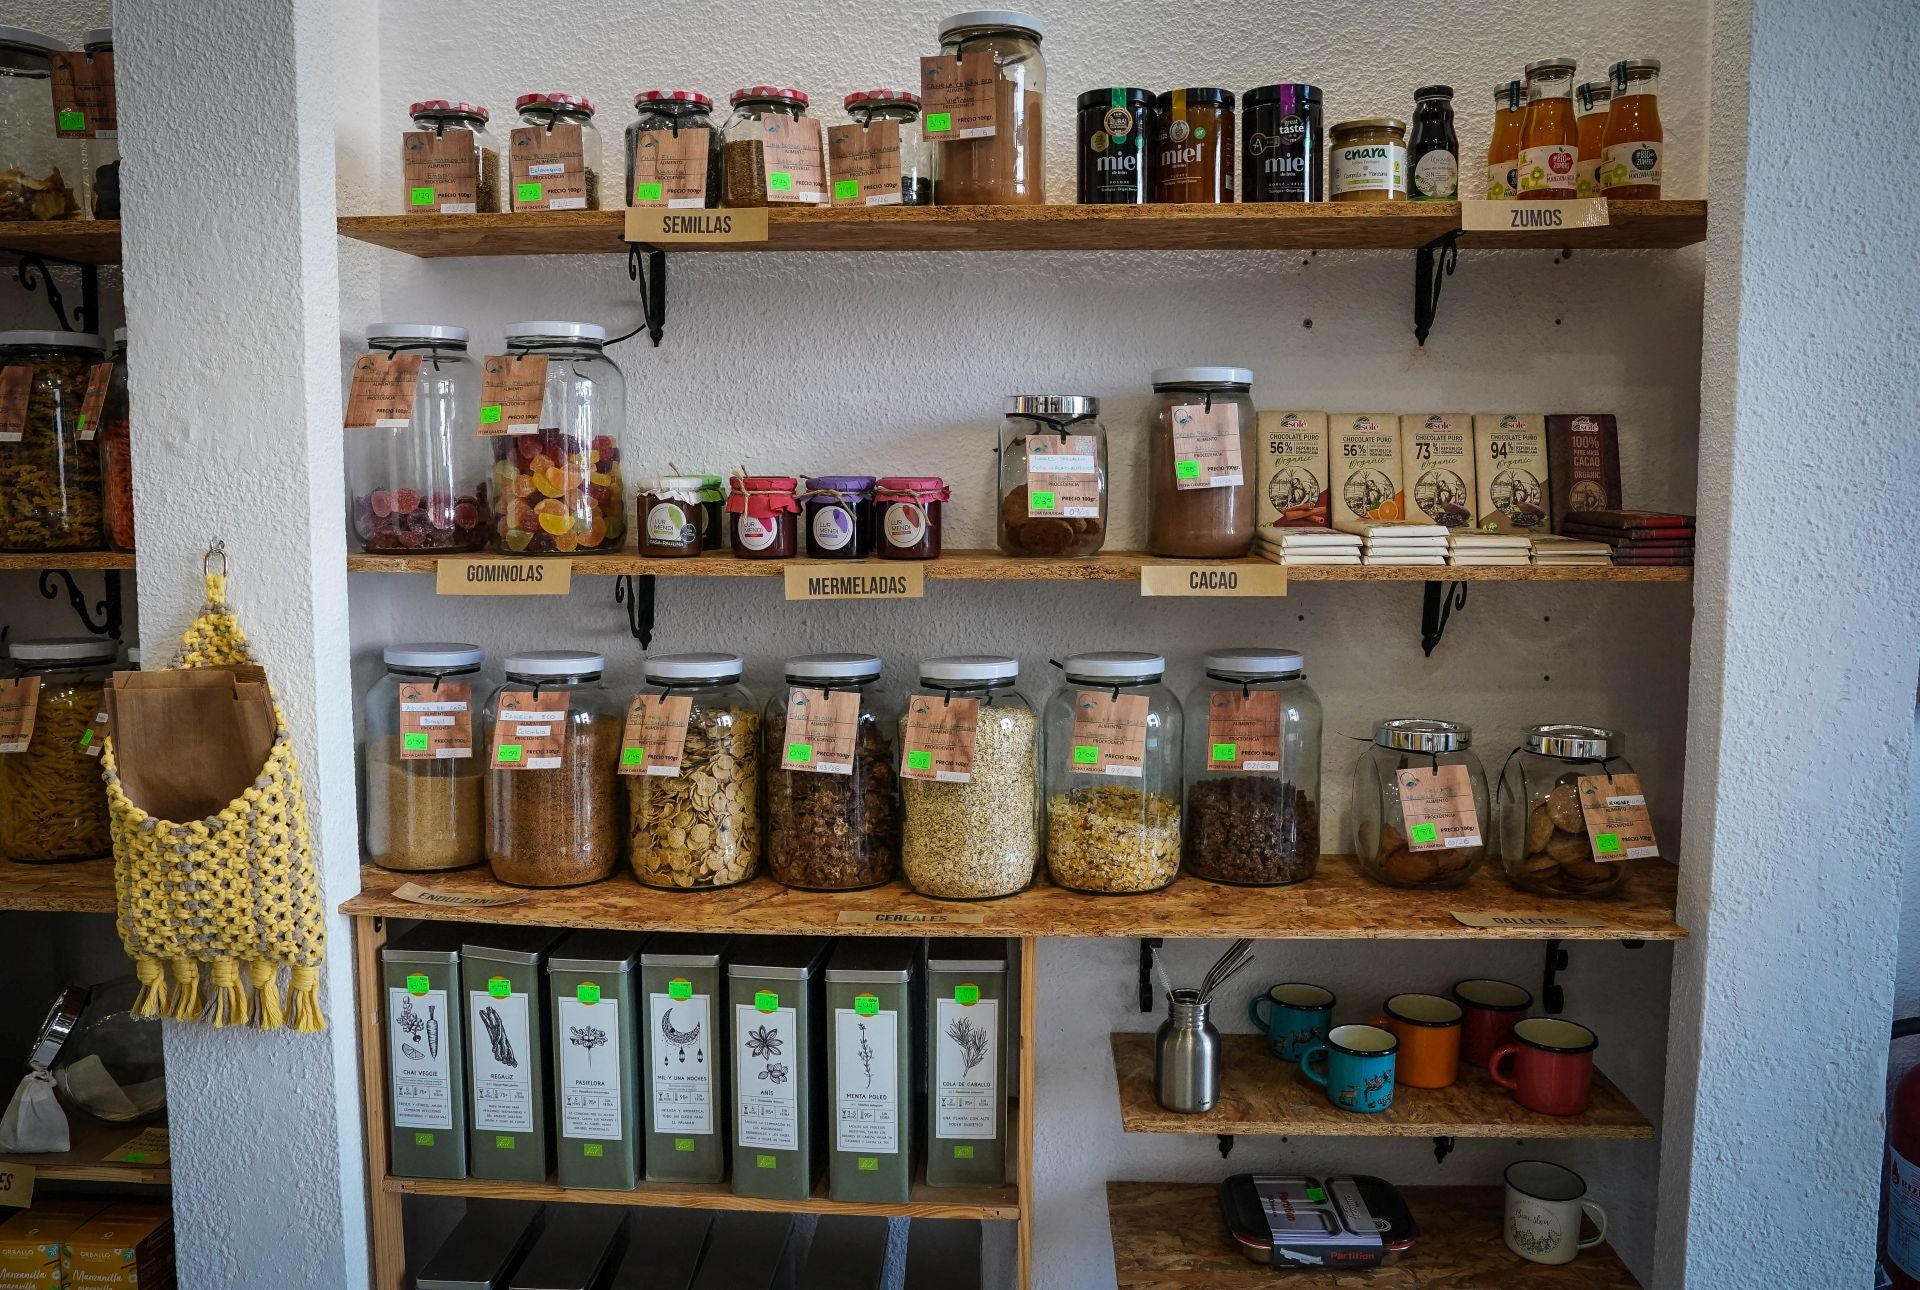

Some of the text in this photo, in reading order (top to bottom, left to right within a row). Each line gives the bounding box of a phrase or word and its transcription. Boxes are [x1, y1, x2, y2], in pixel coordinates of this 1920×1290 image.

[1161, 143, 1203, 166] miel
[1344, 147, 1387, 160] enara
[1097, 151, 1139, 171] mie
[1264, 152, 1307, 173] mie
[662, 215, 732, 234] SEMILLAS
[1510, 209, 1563, 228] ZUMOS
[1270, 441, 1293, 454] 56%
[1571, 435, 1600, 449] 100%
[1343, 444, 1367, 457] 56%
[1415, 442, 1439, 460] 73%
[1490, 441, 1514, 460] 94%
[1573, 456, 1600, 467] CACAO
[1574, 470, 1601, 479] ORGANIC
[466, 564, 544, 582] GOMINOLAS
[808, 576, 907, 596] MERMELADAS
[1189, 571, 1238, 590] CACAO
[875, 913, 948, 922] CEREALES
[575, 1079, 606, 1087] PASIFLORA
[80, 1251, 111, 1259] ORBALLO
[1330, 1251, 1375, 1260] Partition
[73, 1269, 123, 1282] Manzanilla
